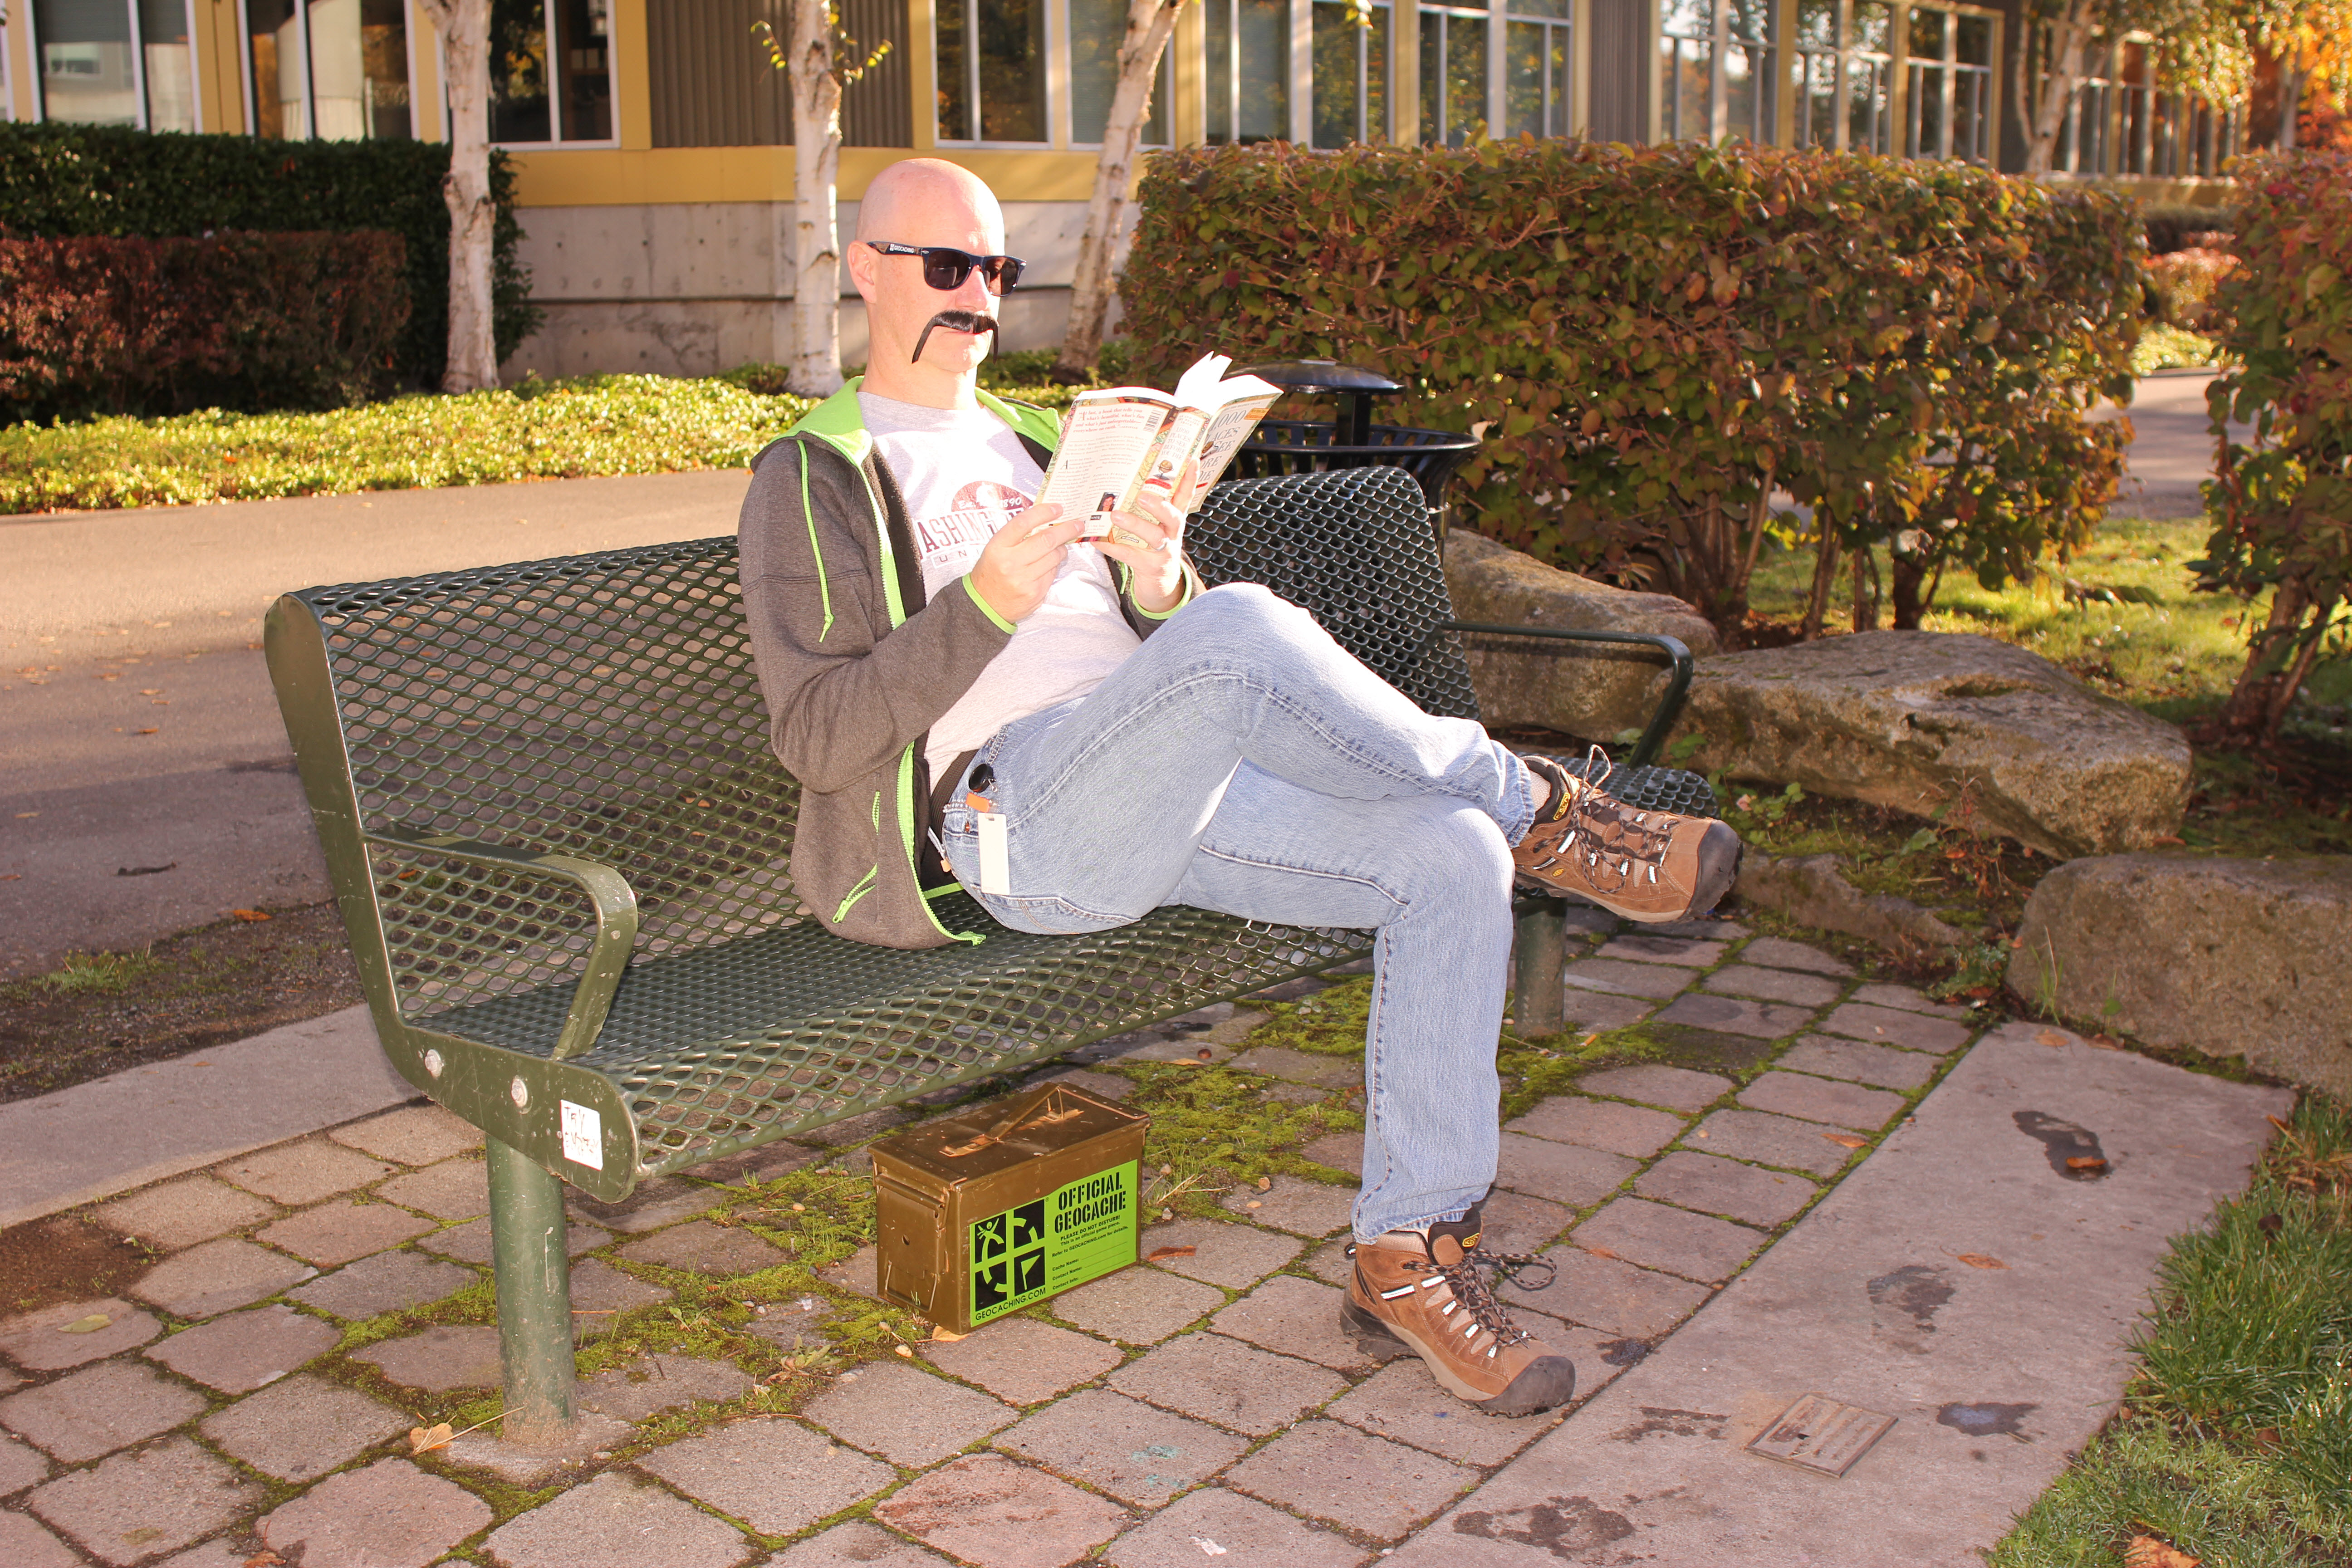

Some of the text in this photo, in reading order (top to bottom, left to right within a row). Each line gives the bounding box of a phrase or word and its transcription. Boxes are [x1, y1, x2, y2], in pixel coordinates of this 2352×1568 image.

[1058, 1172, 1122, 1210] OFFICIAL
[1054, 1191, 1126, 1234] GEOCACHE
[1060, 1230, 1079, 1241] PLEASE
[1098, 1215, 1120, 1226] DISTURB!
[1081, 1230, 1095, 1239] official
[1069, 1234, 1107, 1251] GEOCACHING.com
[1053, 1272, 1068, 1280] Contact
[1053, 1281, 1068, 1289] Contact
[975, 1287, 1046, 1321] GEOCACHING.COM
